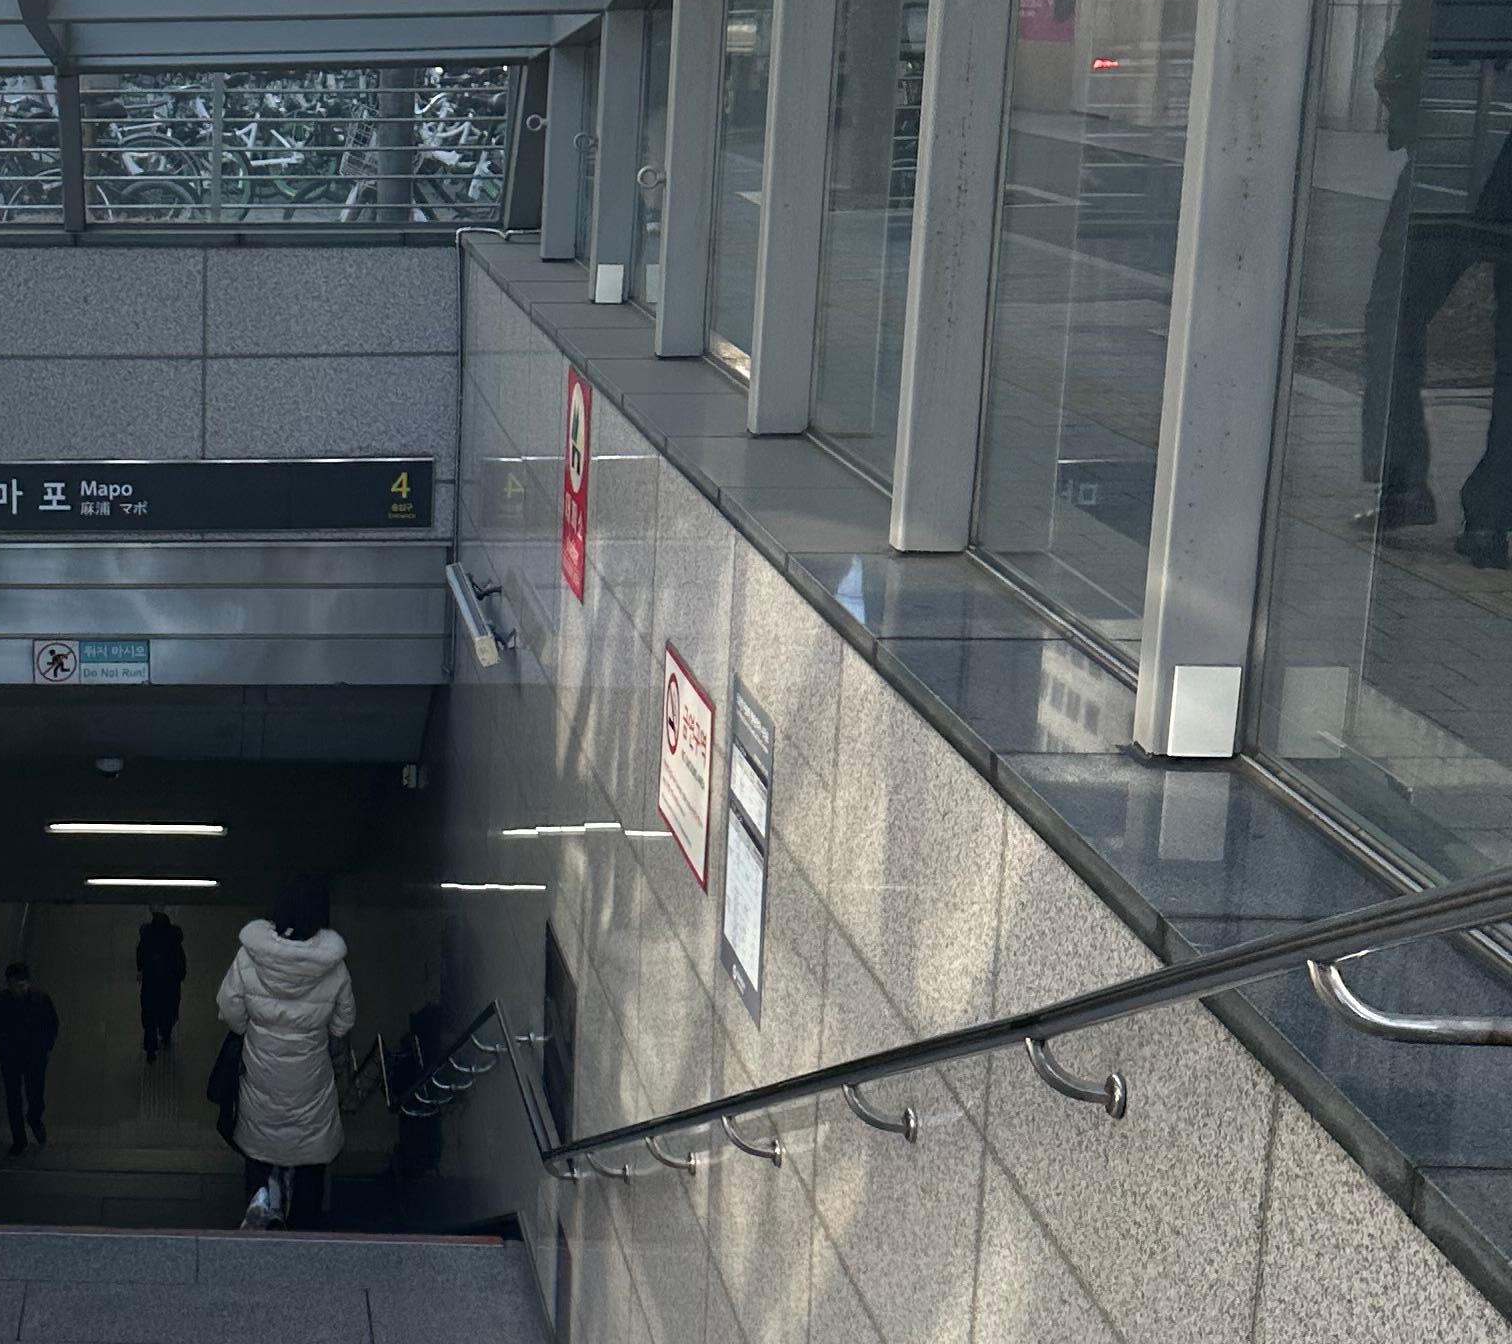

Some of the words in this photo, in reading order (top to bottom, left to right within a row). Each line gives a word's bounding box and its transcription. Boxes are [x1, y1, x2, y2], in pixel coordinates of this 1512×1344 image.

[80, 480, 133, 500] Mapo
[390, 471, 411, 499] 4
[111, 644, 147, 658] 마시오
[83, 668, 98, 678] Do
[101, 668, 119, 678] Not
